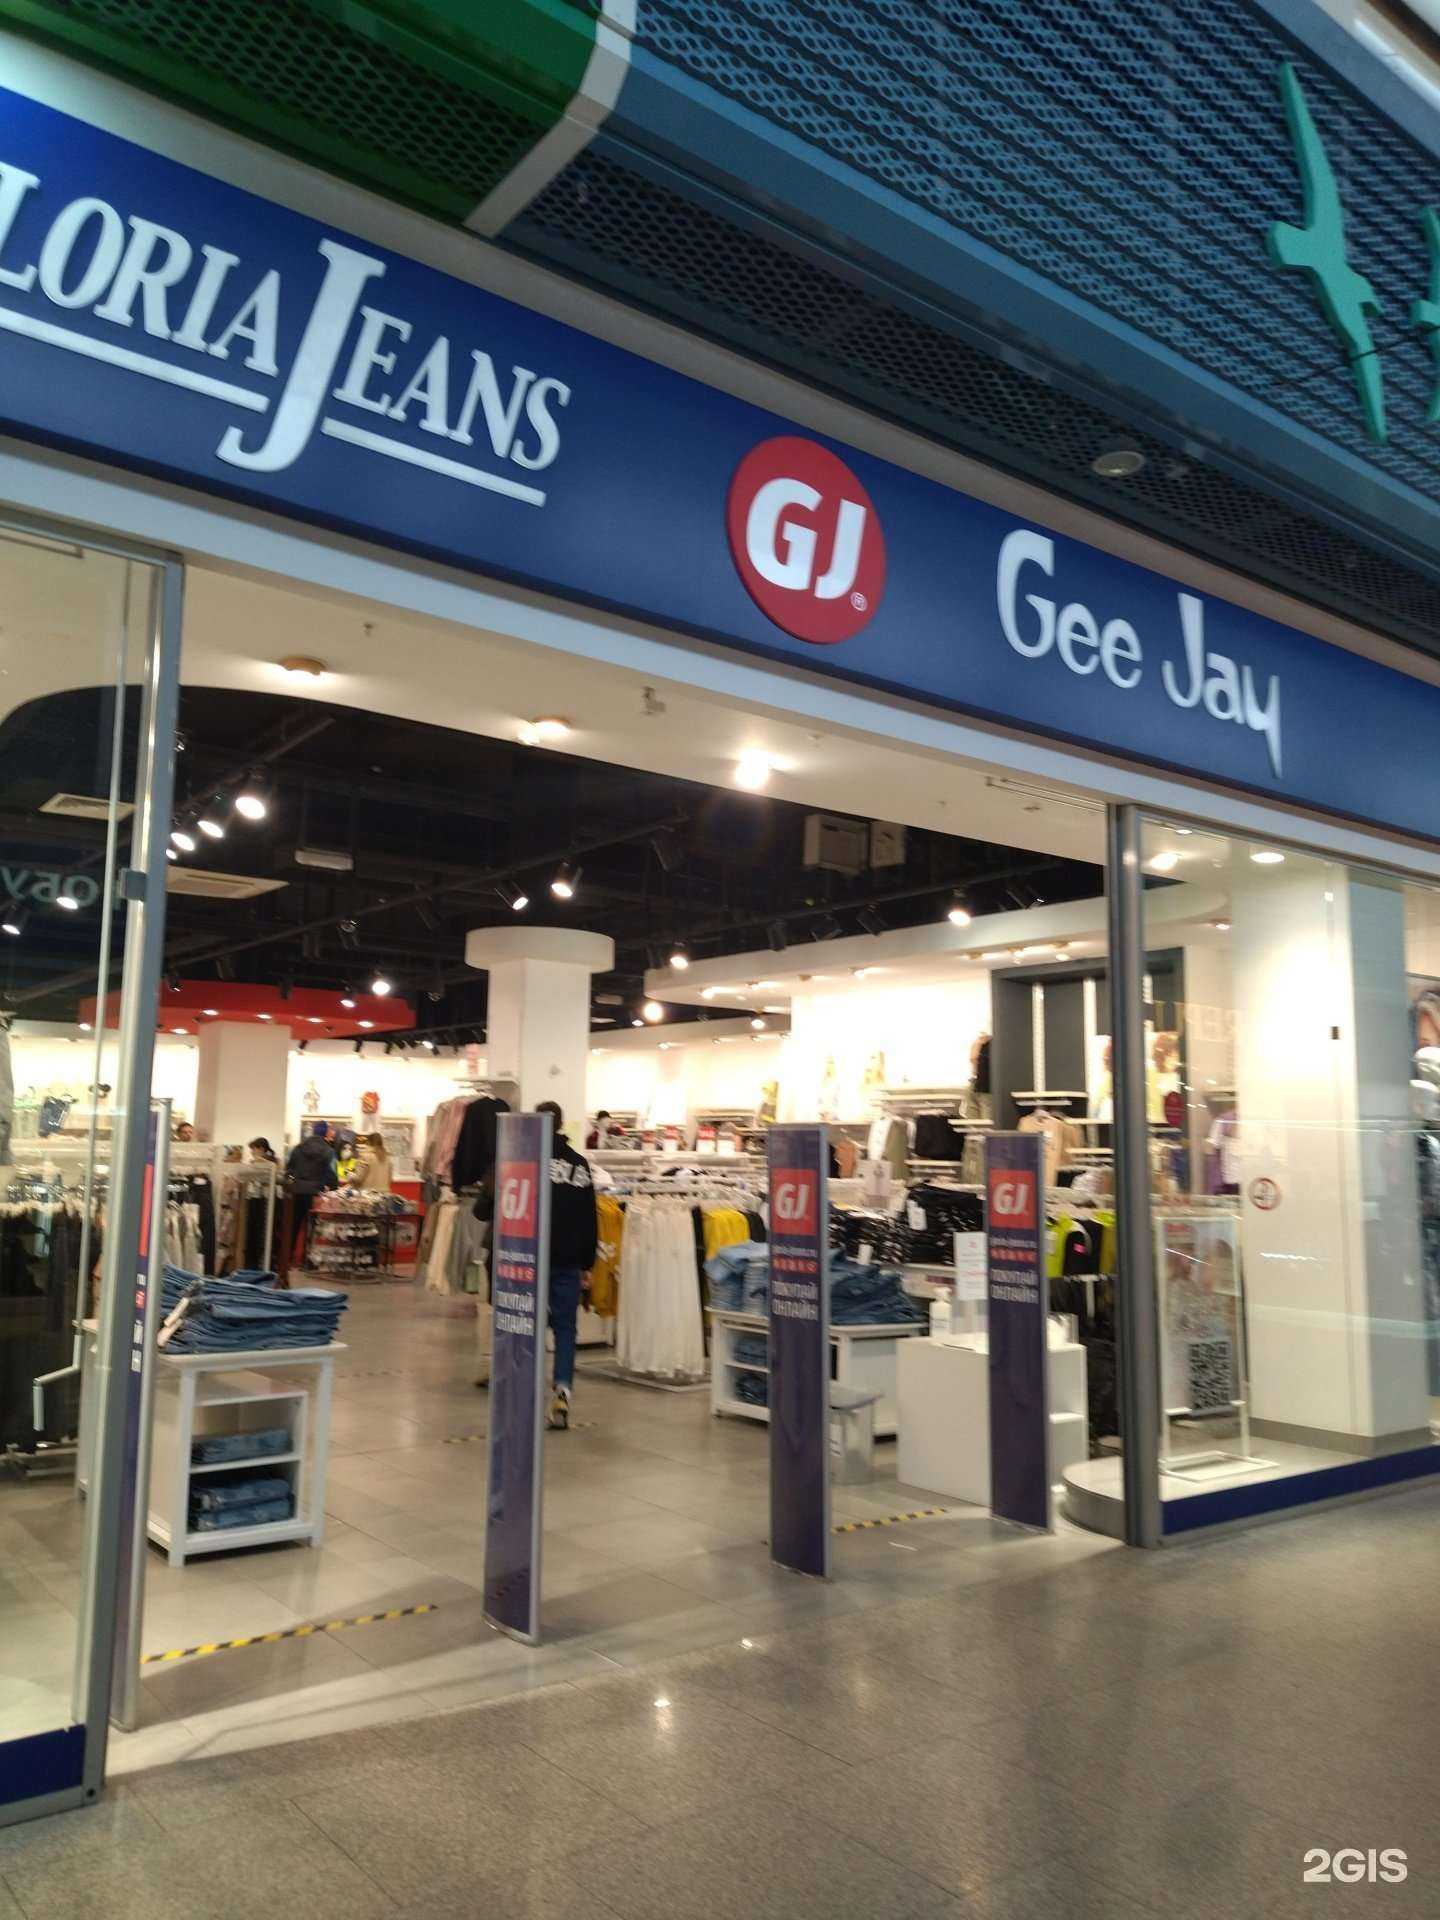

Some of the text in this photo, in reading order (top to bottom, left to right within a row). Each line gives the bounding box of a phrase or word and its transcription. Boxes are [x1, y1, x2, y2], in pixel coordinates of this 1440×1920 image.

[746, 477, 867, 600] GJ
[997, 529, 1282, 779] Gee Jay
[501, 1178, 531, 1220] GJ
[775, 1182, 810, 1220] GJ
[992, 1182, 1029, 1215] GJ
